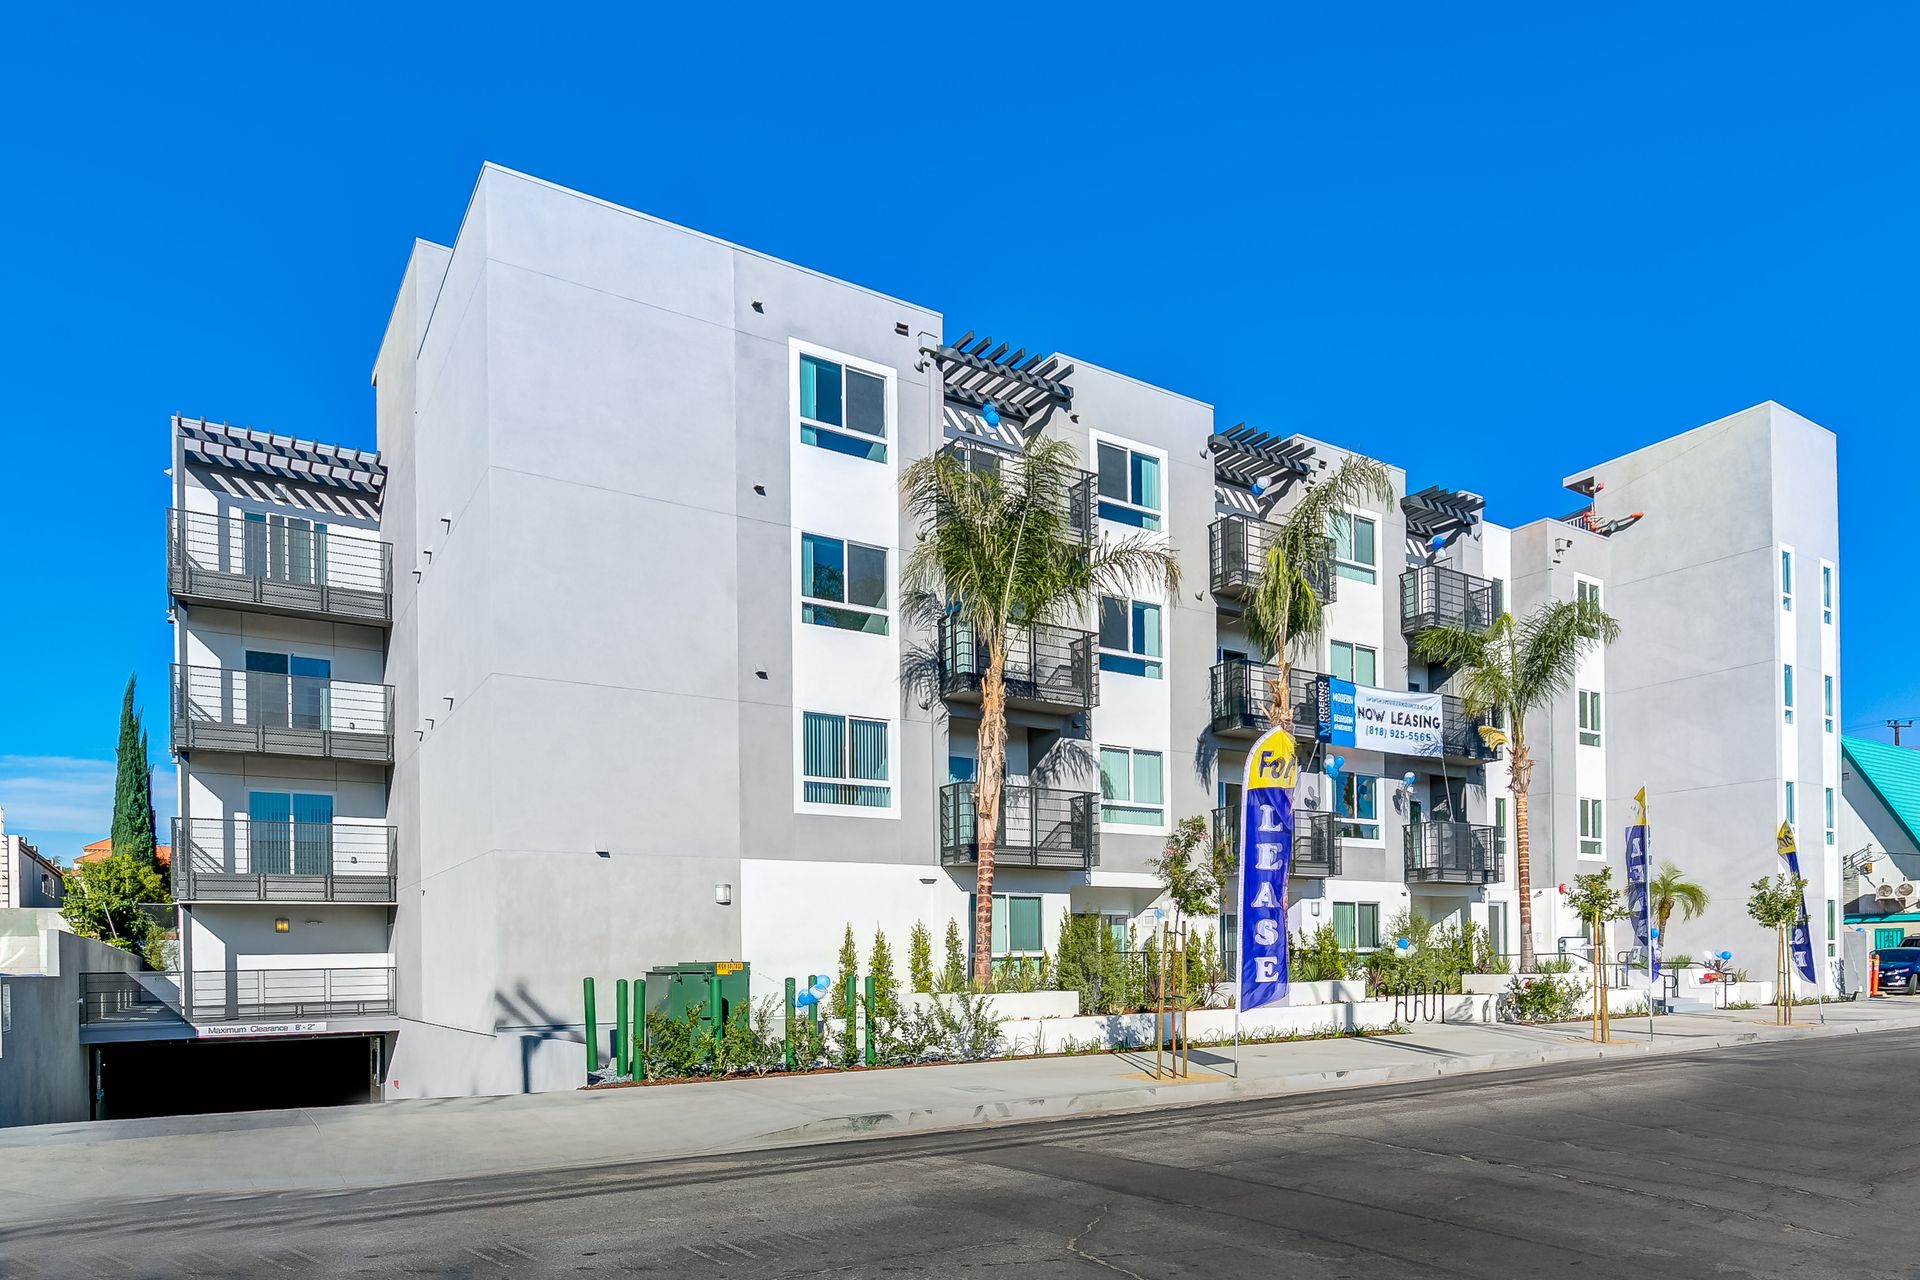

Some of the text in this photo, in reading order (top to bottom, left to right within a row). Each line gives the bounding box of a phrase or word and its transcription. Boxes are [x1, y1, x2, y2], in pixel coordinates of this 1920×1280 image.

[1318, 681, 1330, 737] MODERNO
[1357, 706, 1386, 723] NOW
[1391, 711, 1441, 729] LEASING
[1366, 725, 1432, 742] (818) 925-5565
[1251, 804, 1283, 983] LEASE
[208, 1026, 247, 1034] Maximum
[250, 1025, 289, 1033] Clearance
